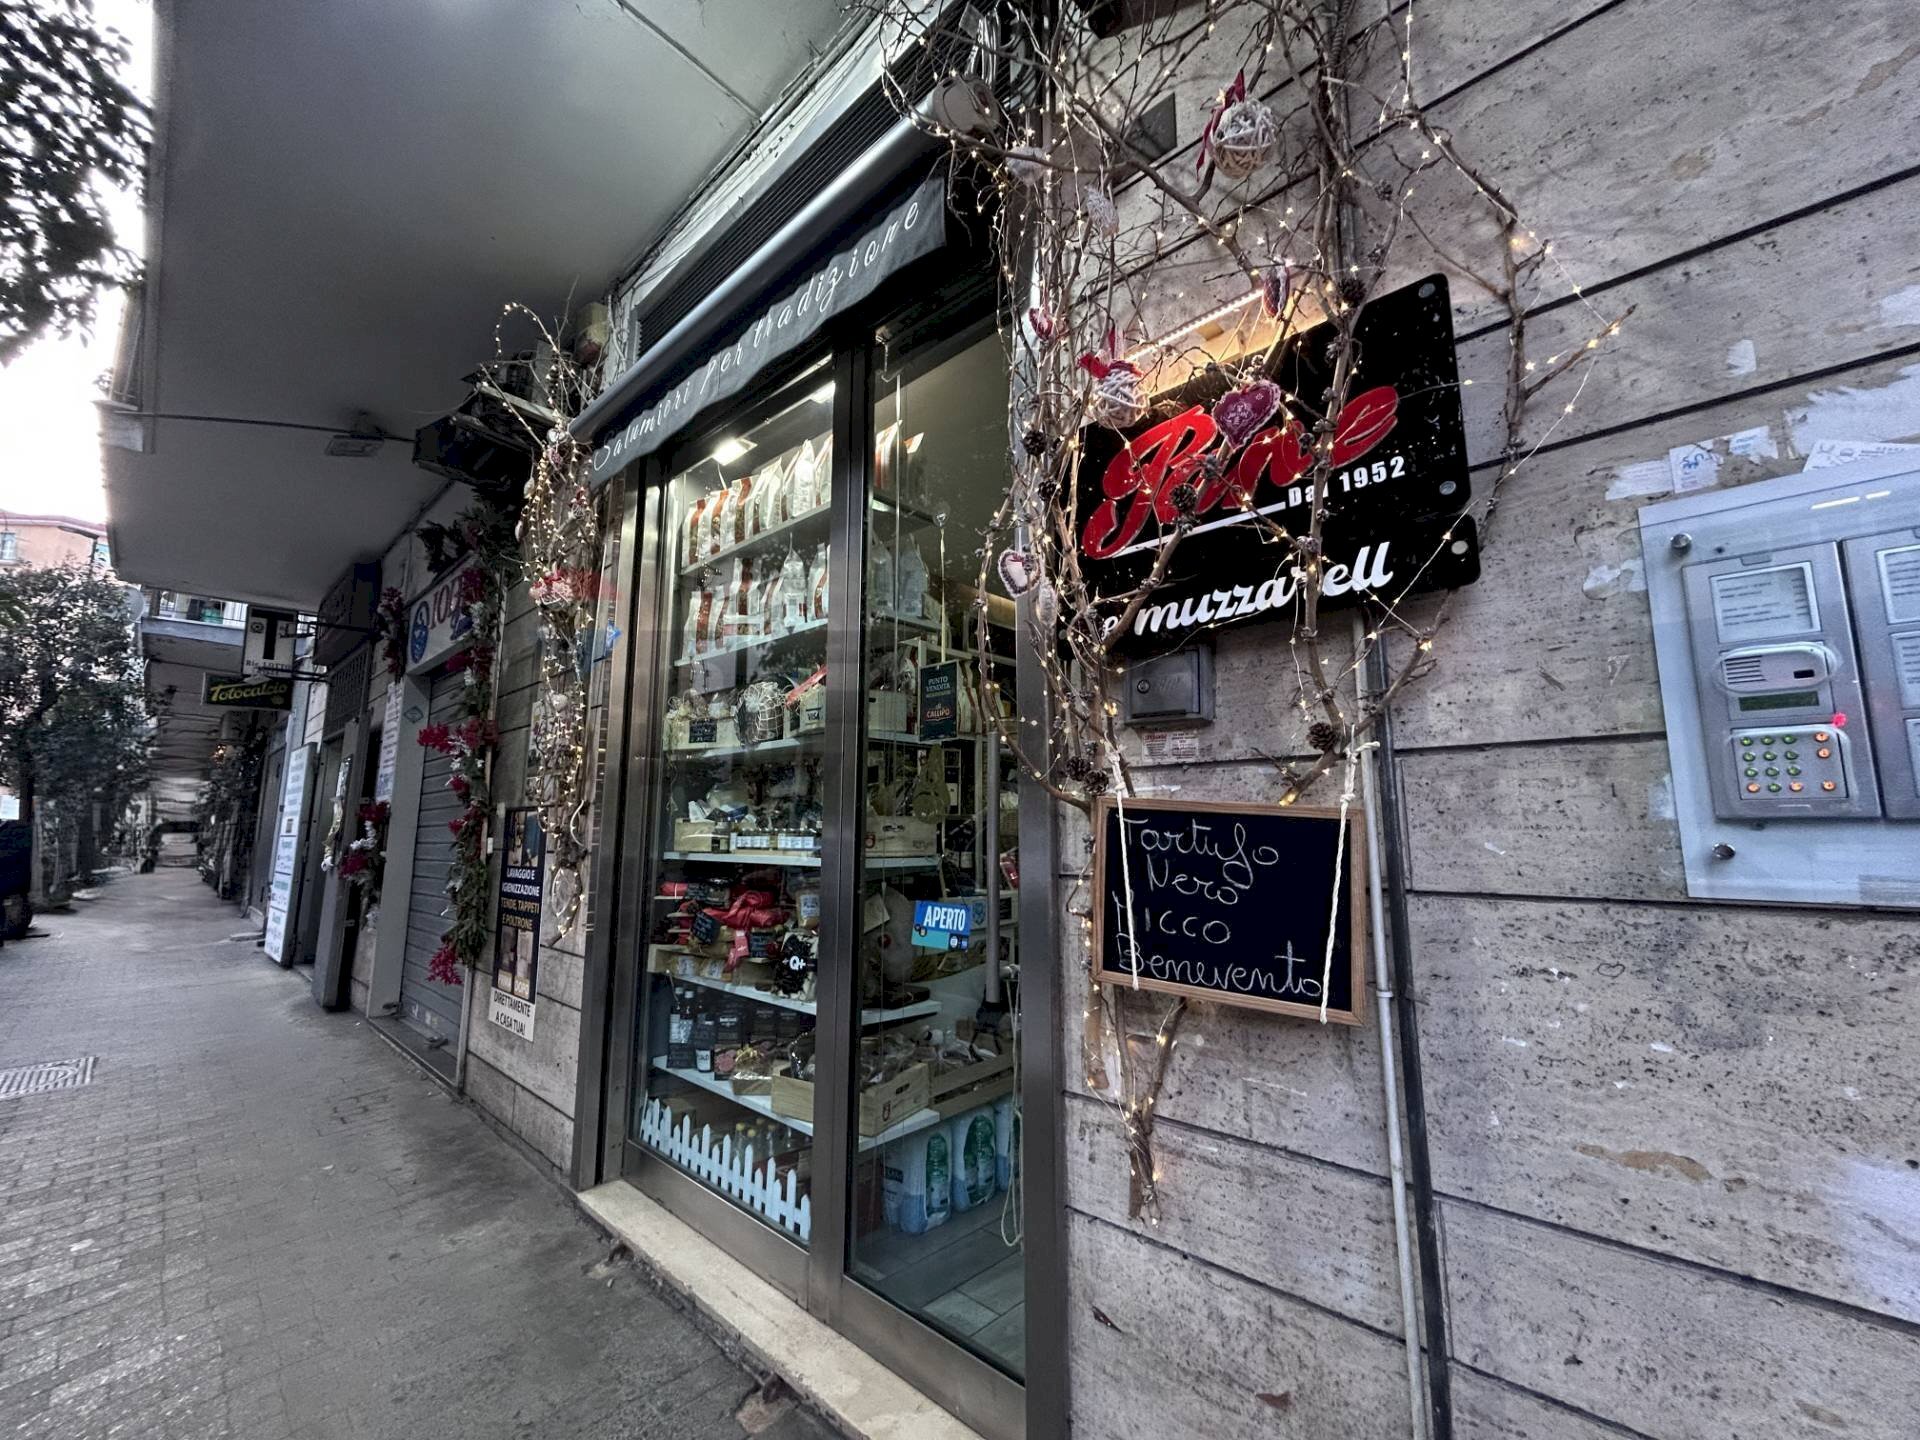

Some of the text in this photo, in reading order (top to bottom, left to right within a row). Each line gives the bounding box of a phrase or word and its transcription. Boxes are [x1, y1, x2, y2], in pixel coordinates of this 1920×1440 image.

[700, 342, 744, 394] per
[753, 202, 919, 348] tradizione
[1339, 456, 1406, 493] 1952
[210, 682, 288, 702] Totocalcio
[1147, 854, 1238, 905] Nero
[923, 905, 966, 931] APERTO
[1116, 933, 1322, 997] Benevento
[500, 1013, 512, 1029] CASA
